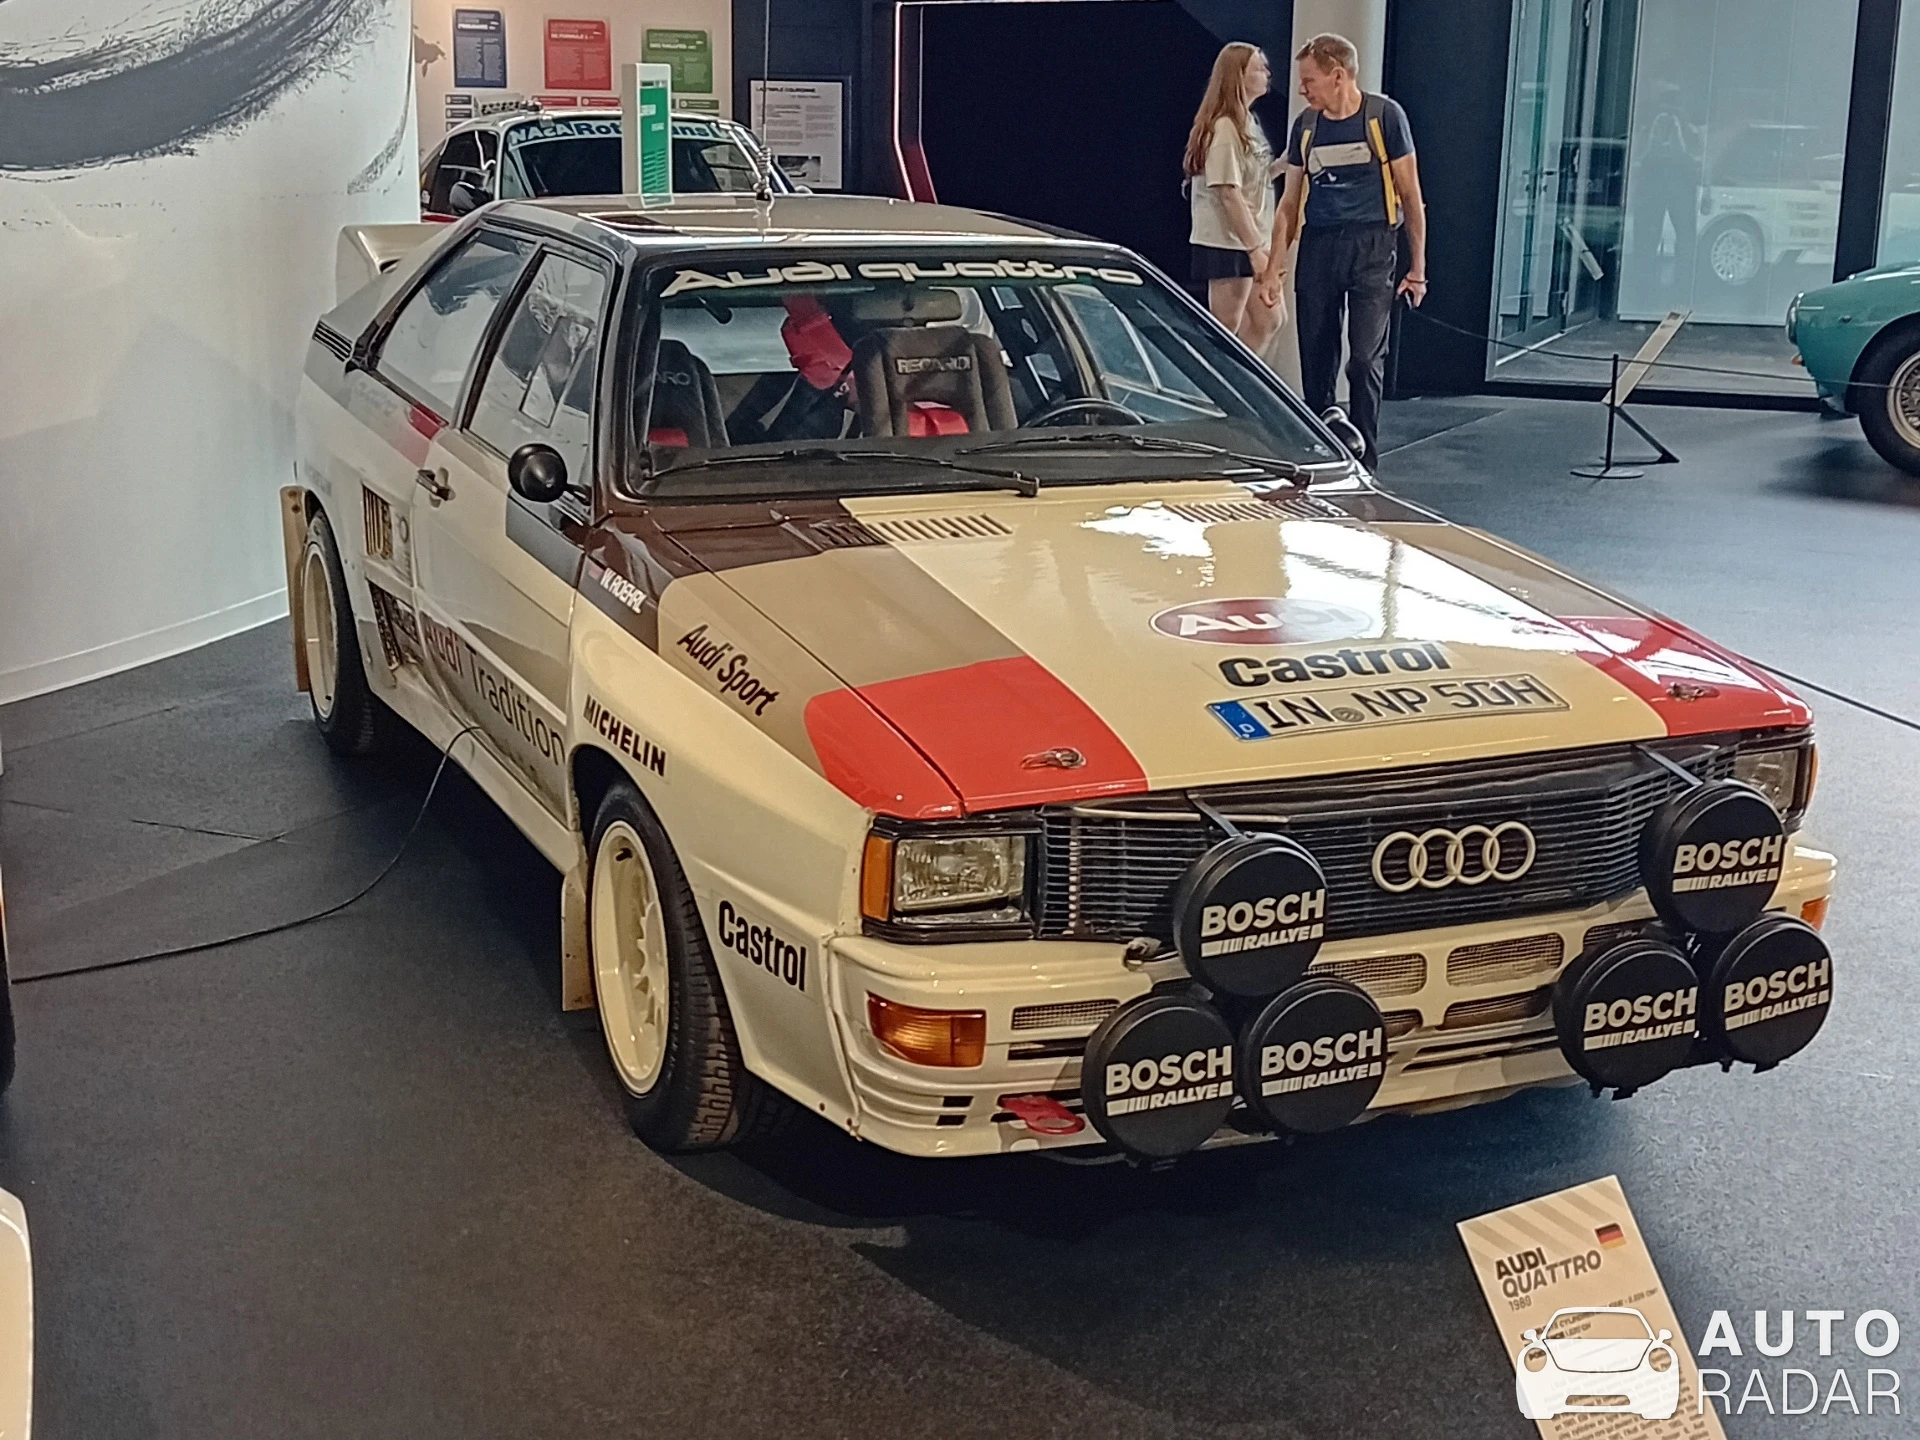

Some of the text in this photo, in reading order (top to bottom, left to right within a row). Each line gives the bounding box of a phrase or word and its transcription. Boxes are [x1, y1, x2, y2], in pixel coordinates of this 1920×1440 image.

[660, 260, 1144, 298] Audi quattro
[676, 623, 780, 717] Audi Sport
[1218, 641, 1452, 688] Castrol
[464, 642, 566, 766] Tradition
[1253, 696, 1334, 729] IN
[1352, 686, 1431, 717] NP
[583, 694, 667, 778] MICHELIN
[1673, 834, 1783, 874] BOSCH
[1708, 869, 1768, 889] RALLYE
[1201, 888, 1326, 938] BOSCH
[718, 900, 807, 993] Castrol
[1242, 925, 1312, 951] RALLYE
[1723, 957, 1829, 1013] BOSCH
[1759, 992, 1818, 1021] RALLYE
[1583, 986, 1698, 1032] BOSCH
[1261, 1027, 1382, 1077] BOSCH
[1621, 1021, 1684, 1045] RALLYE
[1105, 1045, 1232, 1096] BOSCH
[1302, 1063, 1369, 1090] RALLYE
[1149, 1083, 1219, 1110] RALLYE
[1495, 1247, 1547, 1281] AUDI
[1502, 1249, 1602, 1299] QUATTRO
